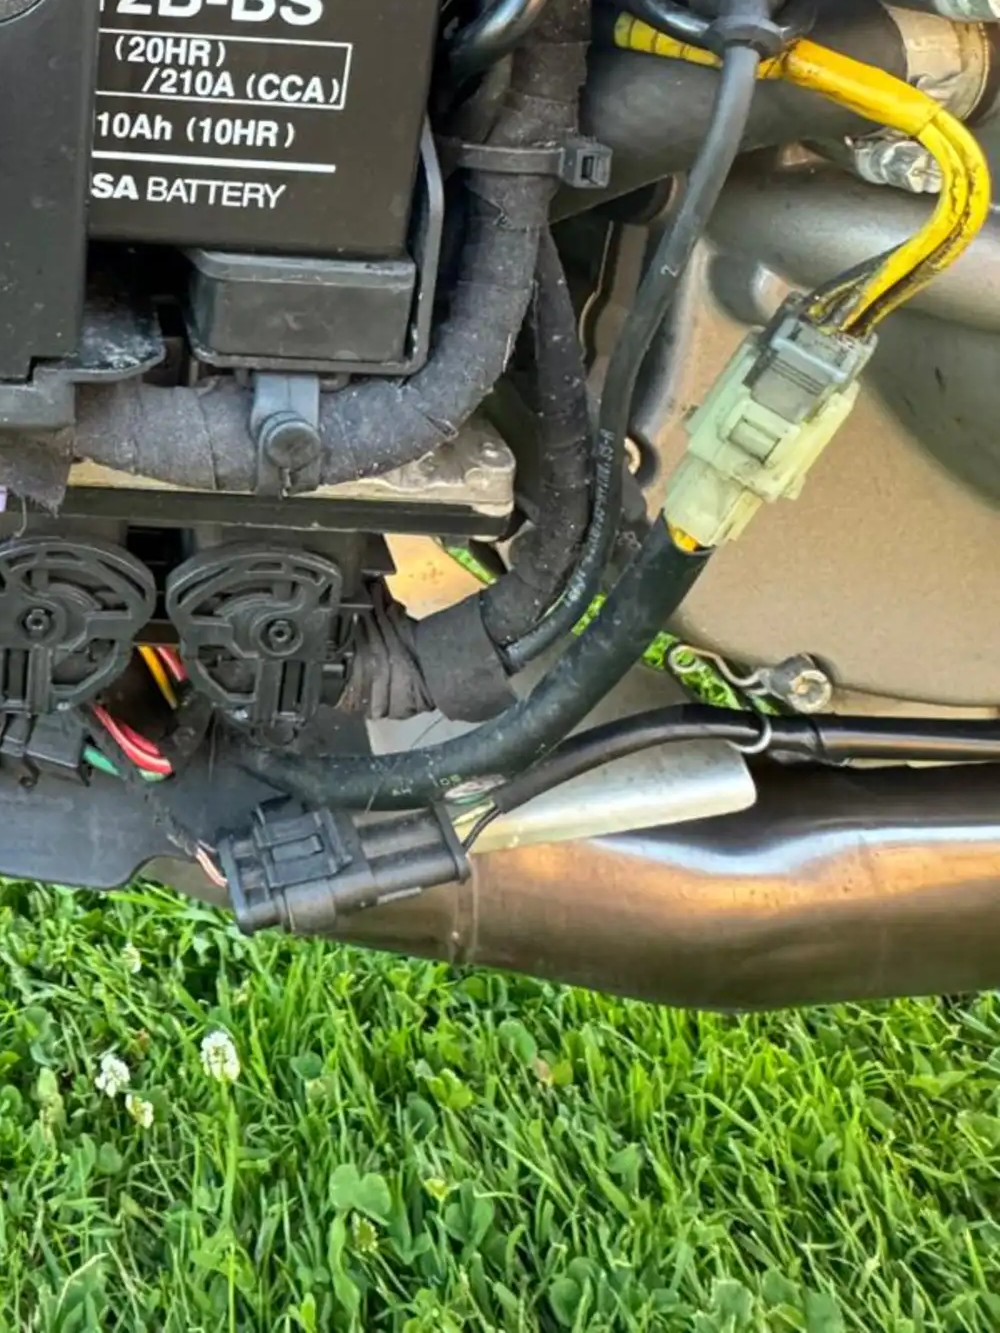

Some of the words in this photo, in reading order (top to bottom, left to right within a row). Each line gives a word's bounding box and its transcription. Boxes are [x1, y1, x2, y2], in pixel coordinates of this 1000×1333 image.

[115, 35, 226, 67] (20HR)
[141, 67, 235, 98] /210A
[246, 73, 340, 104] (CCA)
[97, 111, 173, 141] 10Ah
[186, 116, 295, 148] (10HR)
[90, 172, 139, 200] SA
[146, 176, 287, 209] BATTERY
